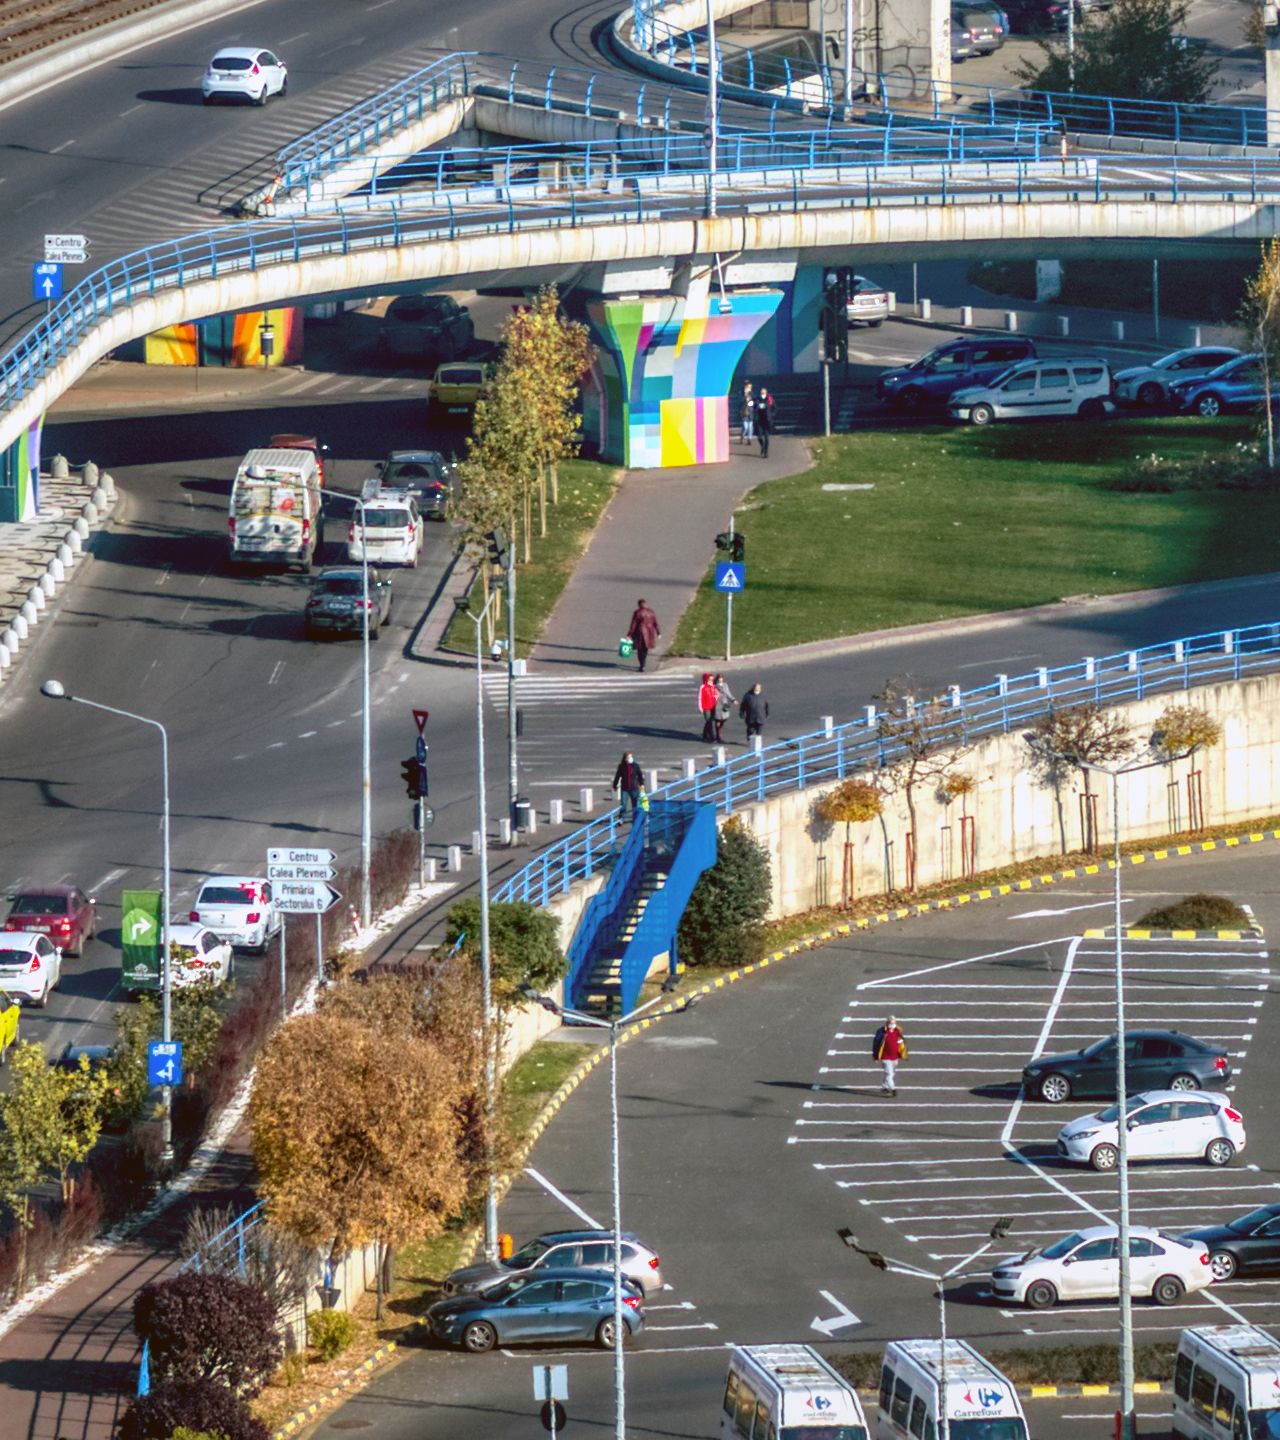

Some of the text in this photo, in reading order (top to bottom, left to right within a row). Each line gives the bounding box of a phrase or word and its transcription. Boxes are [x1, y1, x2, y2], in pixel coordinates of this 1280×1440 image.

[55, 237, 81, 247] Centru
[289, 851, 319, 862] Centru
[270, 867, 327, 878] Calea Plevnei
[274, 897, 323, 909] Sectorului 6
[953, 1409, 1003, 1418] Carrefour
